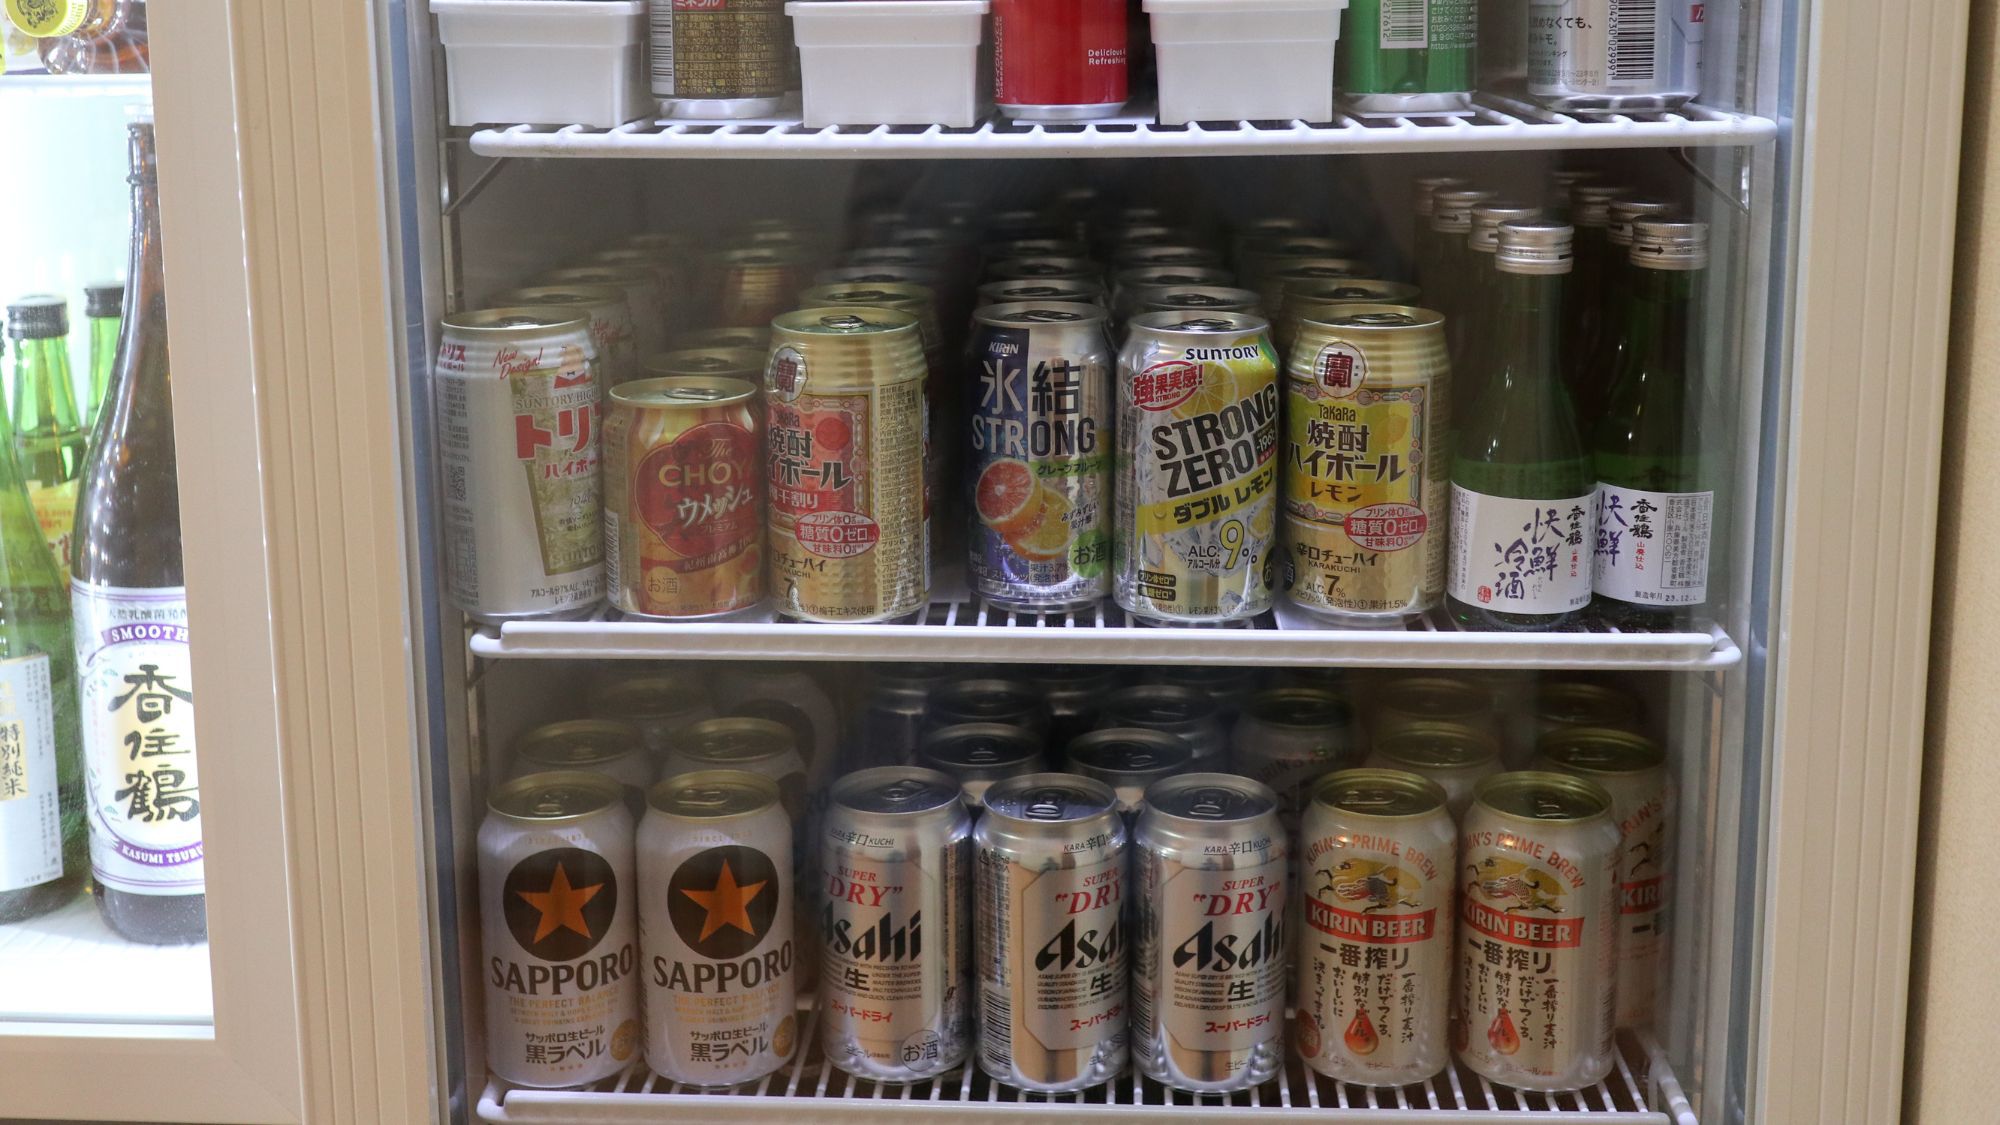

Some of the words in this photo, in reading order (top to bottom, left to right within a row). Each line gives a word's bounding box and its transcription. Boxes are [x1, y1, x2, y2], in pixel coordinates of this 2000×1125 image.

[1088, 48, 1122, 57] Delicious
[493, 347, 518, 368] New
[989, 341, 1019, 354] KIRIN
[1185, 345, 1259, 361] SUNTORY
[500, 347, 543, 380] Design!
[980, 358, 1081, 417] 氷結
[515, 393, 574, 410] SUNTORY
[1151, 383, 1277, 461] STRONG
[972, 414, 1095, 457] STRONG
[1308, 419, 1370, 453] 焼酎
[1160, 439, 1255, 498] ZERO
[1289, 442, 1407, 482] ハイボール
[1174, 494, 1231, 525] ダブル
[1234, 466, 1273, 504] レモン
[1311, 481, 1362, 503] レモン
[1351, 518, 1418, 536] 糖質0ゼロ
[1629, 498, 1658, 539] 香住鶴
[1074, 540, 1106, 566] お酒
[1187, 545, 1221, 558] ALC.
[1296, 542, 1379, 567] 辛口チューハイ
[1308, 559, 1361, 574] KARAKUCHI
[648, 576, 678, 594] お酒
[111, 625, 189, 642] SMOOTH
[108, 664, 200, 823] 香住鶴
[868, 838, 895, 846] KUCHI
[1063, 843, 1085, 852] KARA
[121, 845, 164, 865] KASUMI
[1351, 833, 1400, 857] PRIME
[1404, 847, 1438, 882] BREW
[1496, 833, 1545, 860] PRIME
[1547, 851, 1585, 889] BREW
[838, 865, 877, 883] SUPER
[1222, 876, 1265, 891] SUPER
[821, 900, 921, 963] Asahi
[1311, 904, 1367, 936] KIRIN
[1371, 917, 1426, 938] BEER
[1513, 921, 1571, 943] BEER
[653, 940, 792, 994] SAPPORO
[1319, 942, 1409, 970] 一番搾り
[1468, 938, 1553, 974] 一番搾り
[491, 943, 633, 996] SAPPORO
[844, 967, 870, 992] 生
[1090, 972, 1112, 997] 生
[1228, 979, 1255, 1003] 生
[1332, 966, 1346, 1018] おいしいに
[1478, 963, 1489, 1014] おいしいに
[831, 1000, 893, 1024] スーパードライ
[1400, 972, 1417, 1044] 一番搾り麦汁
[1541, 978, 1559, 1049] 一番搾り麦汁
[690, 1021, 769, 1042] サッポロ生ビール
[1205, 1011, 1271, 1033] スーパードライ
[525, 1025, 606, 1045] サッポロ生ビール
[525, 1039, 607, 1065] 黒ラベル
[690, 1036, 769, 1063] 黒ラベル
[904, 1039, 939, 1062] お酒
